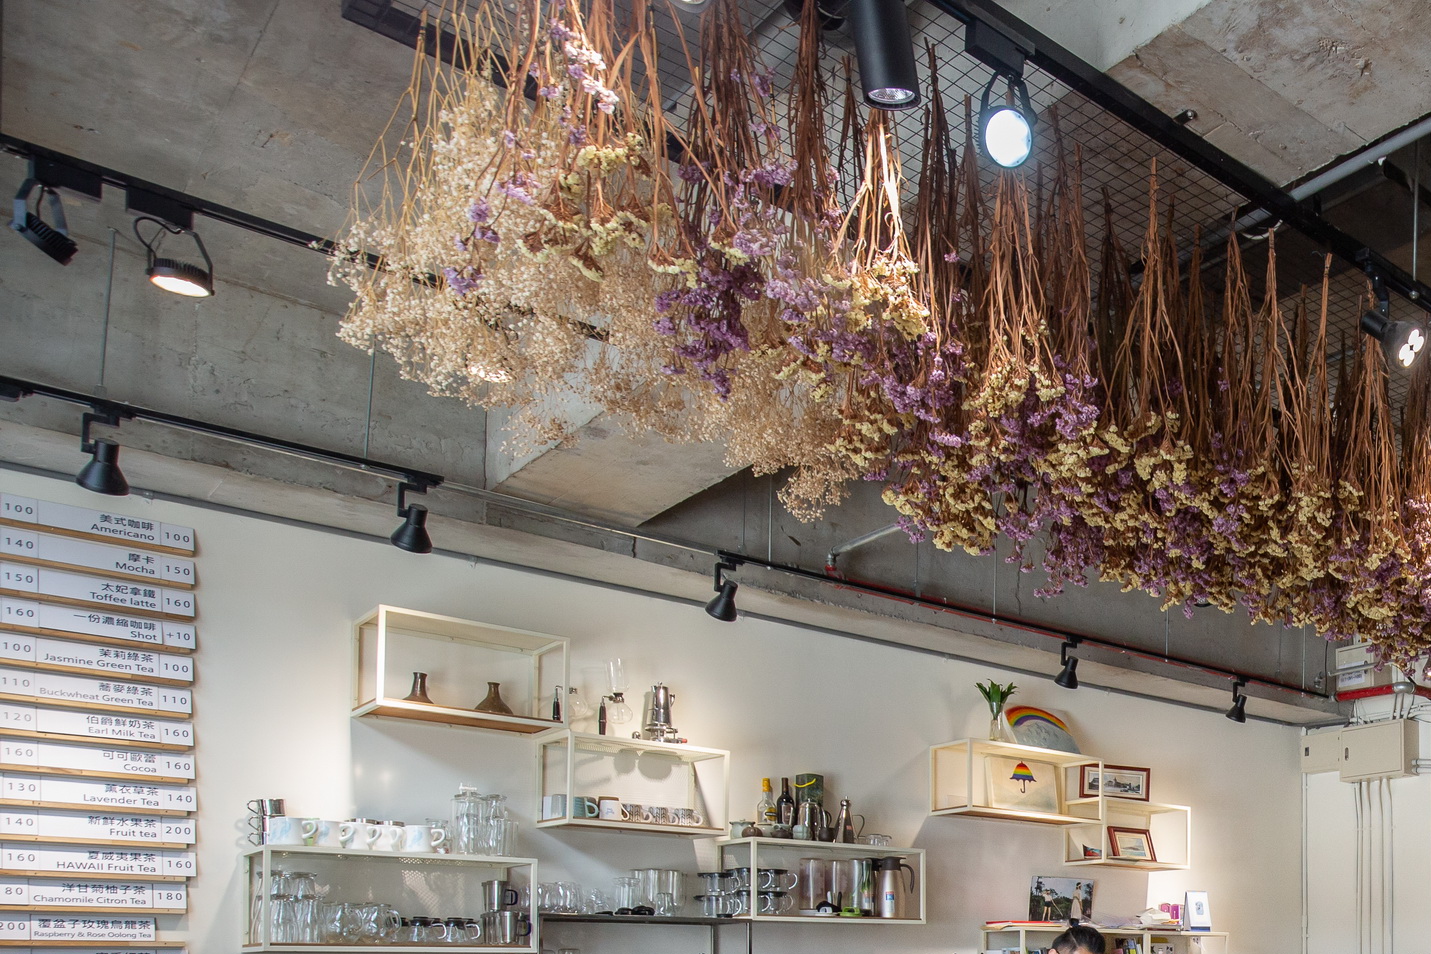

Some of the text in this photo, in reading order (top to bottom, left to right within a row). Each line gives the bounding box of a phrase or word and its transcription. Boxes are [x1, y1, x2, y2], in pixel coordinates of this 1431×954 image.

[5, 503, 33, 515] 100
[100, 513, 154, 531] 美式咖啡
[91, 523, 155, 541] Americano
[165, 531, 190, 543] 100
[5, 537, 34, 549] 140
[128, 553, 155, 564] 摩卡
[115, 562, 155, 575] Mocha
[165, 565, 190, 576] 150
[5, 572, 33, 584] 150
[101, 583, 156, 598] 太妃拿鐵
[90, 592, 156, 609] Toffee latte
[165, 598, 191, 608] 160
[6, 606, 34, 618] 160
[73, 614, 156, 631] 一份濃縮咖啡
[130, 631, 157, 641] Shot
[166, 632, 191, 641] +10
[3, 642, 31, 653] 100
[99, 648, 153, 663] 茉莉綠茶
[44, 653, 154, 674] Jasmine Green Tea
[164, 663, 188, 673] 100
[2, 677, 30, 687] 110
[98, 682, 153, 697] 蕎麥綠茶
[40, 687, 154, 707] Buckwheat Green Tea
[162, 695, 187, 705] 110
[3, 712, 32, 722] 120
[86, 715, 155, 730] 伯爵鮮奶茶
[88, 727, 156, 740] Earl Milk Tea
[164, 729, 189, 738] 160
[5, 747, 34, 757] 160
[103, 750, 157, 764] 可可歐蕾
[124, 763, 157, 773] Cocoa
[166, 761, 191, 771] 160
[8, 782, 36, 792] 130
[104, 784, 159, 796] 薰衣草茶
[83, 794, 160, 807] Lavender Tea
[168, 794, 192, 803] 140
[5, 817, 34, 827] 140
[87, 816, 156, 828] 新鮮水果茶
[109, 828, 157, 838] Fruit tea
[165, 826, 191, 835] 200
[7, 853, 36, 862] 160
[87, 850, 156, 863] 夏威夷果茶
[56, 861, 156, 873] HAWAII Fruit Tea
[167, 860, 192, 869] 160
[61, 883, 146, 895] 洋甘菊柚子茶
[33, 894, 147, 905] Chamomile Citron Tea
[157, 892, 183, 901] 180
[37, 918, 151, 930] 覆盆子玫瑰烏龍茶
[34, 930, 75, 939] Raspberry
[107, 931, 137, 939] Oolong
